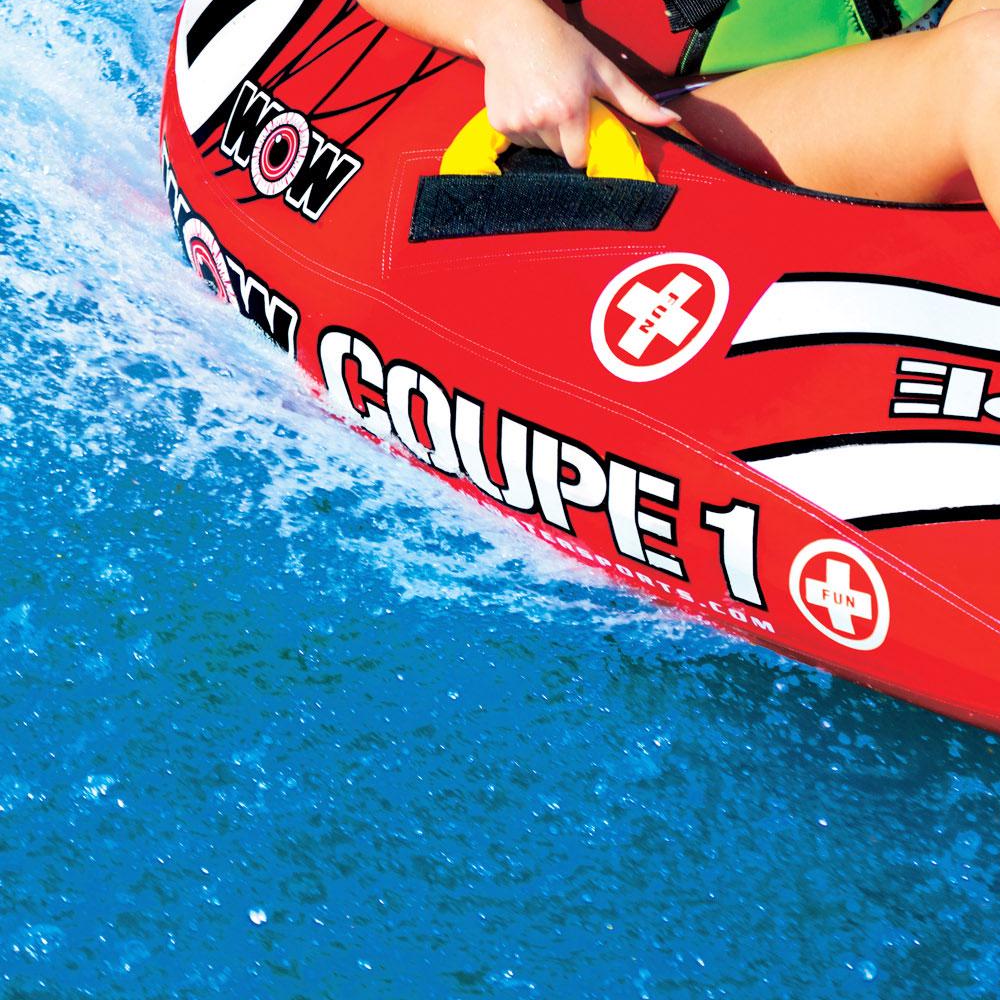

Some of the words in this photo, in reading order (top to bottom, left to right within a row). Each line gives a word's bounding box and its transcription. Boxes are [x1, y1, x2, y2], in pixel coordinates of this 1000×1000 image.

[220, 78, 364, 222] WOW
[638, 291, 680, 335] FUN
[319, 326, 690, 581] COUPE
[700, 498, 768, 611] 1
[821, 588, 856, 609] FUN
